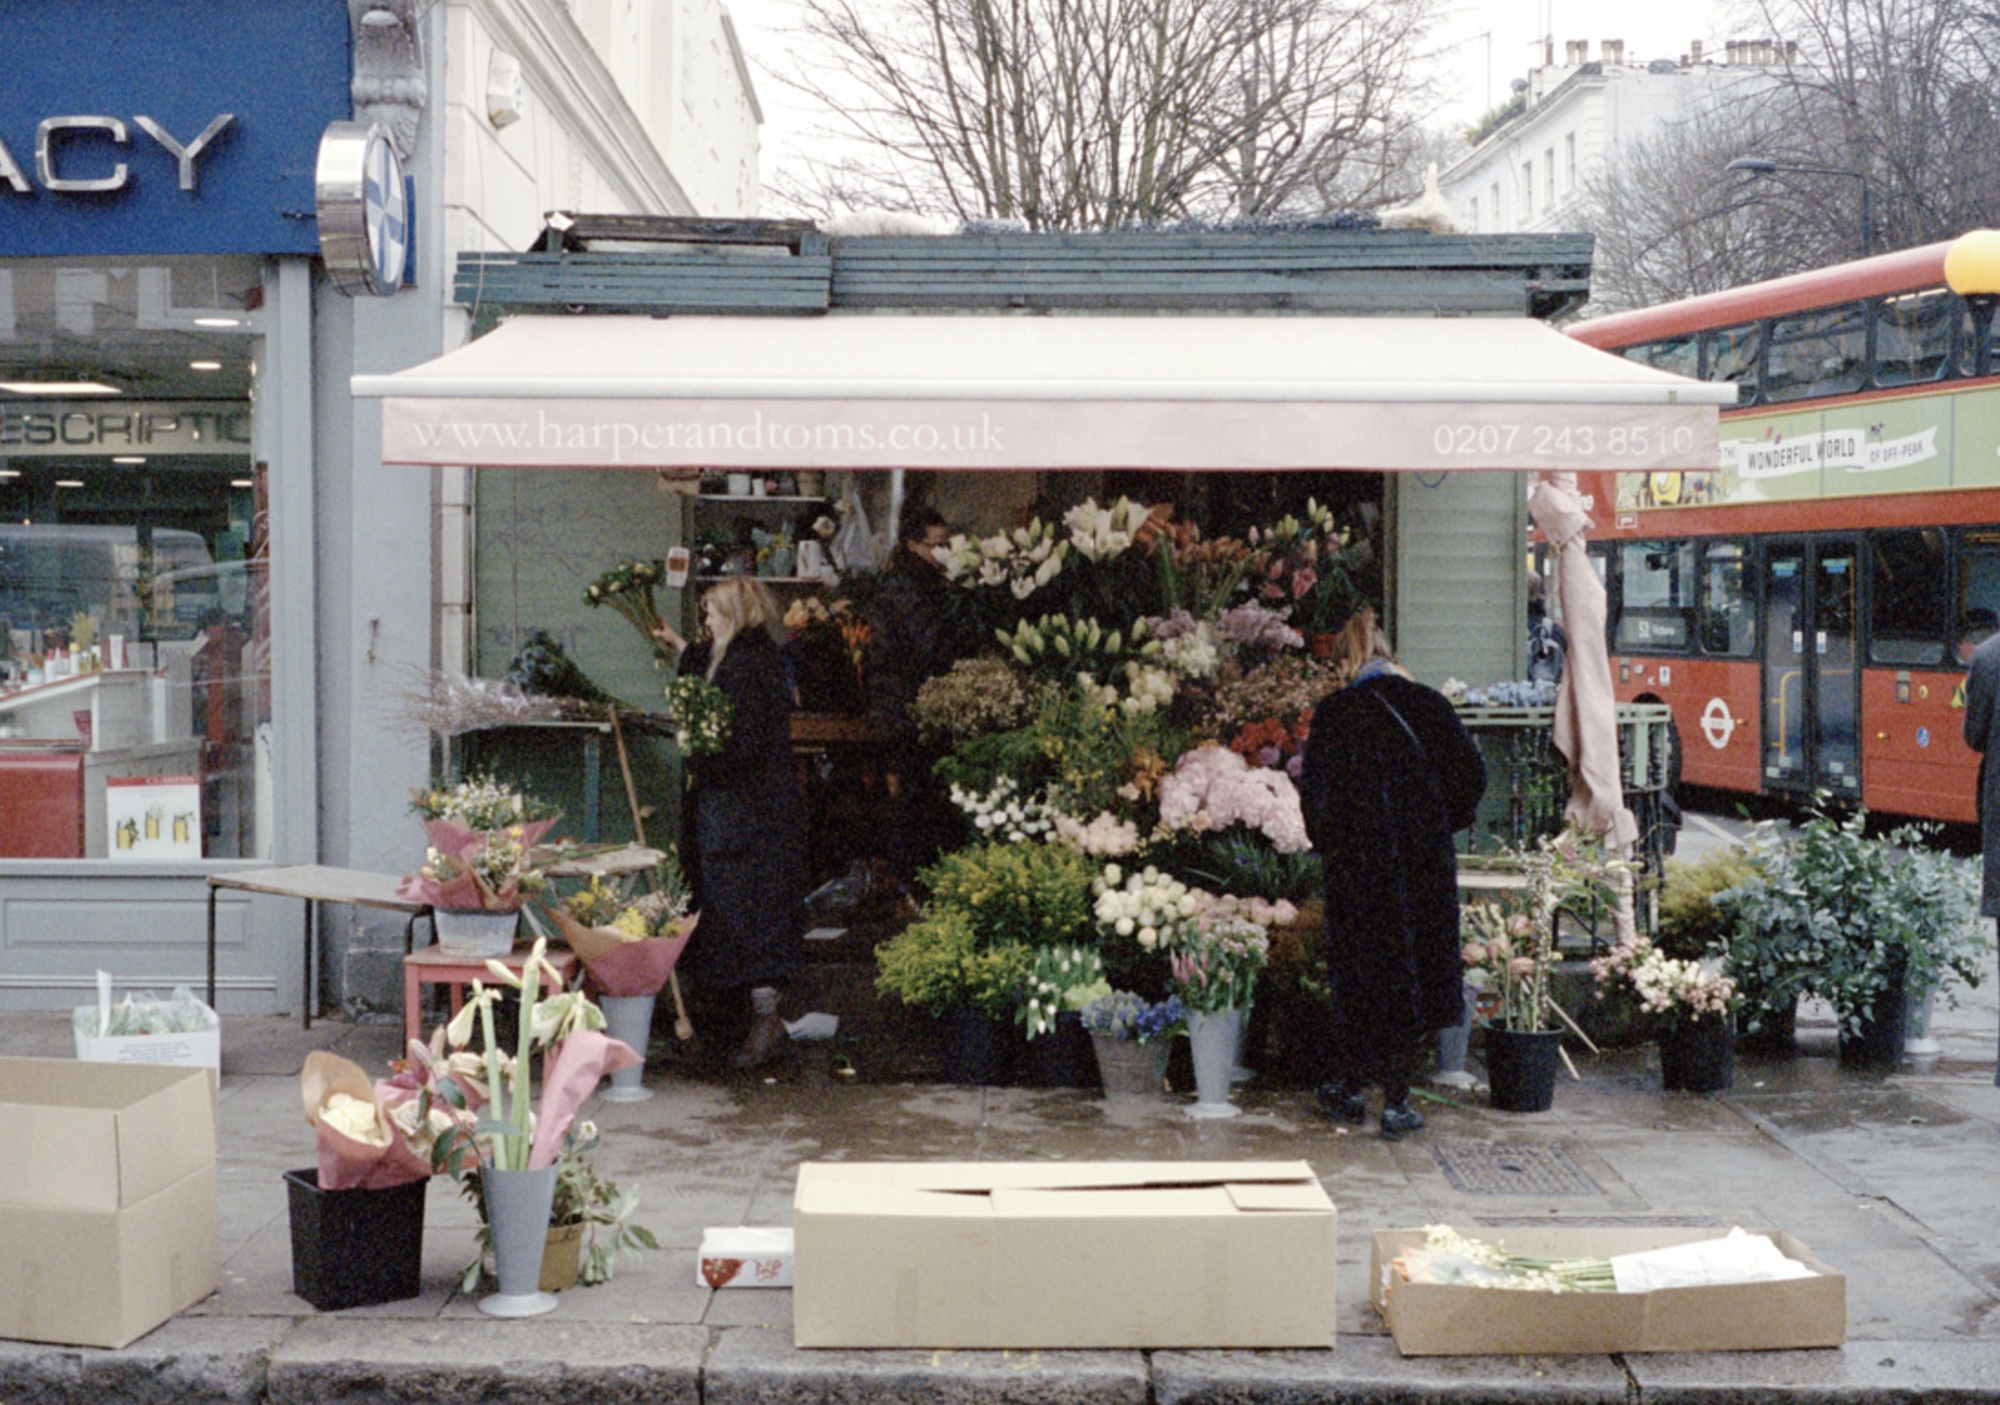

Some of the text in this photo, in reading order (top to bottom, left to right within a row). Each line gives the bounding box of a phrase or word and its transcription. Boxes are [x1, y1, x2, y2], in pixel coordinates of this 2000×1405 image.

[412, 409, 1006, 463] www.harperandtoms.co.uk
[1433, 425, 1693, 456] 0207 243 8510
[1748, 443, 1813, 470] WONDERFUL
[1815, 437, 1855, 459] WORLD
[1870, 449, 1880, 463] OF
[1883, 441, 1923, 462] OFF-PEAK
